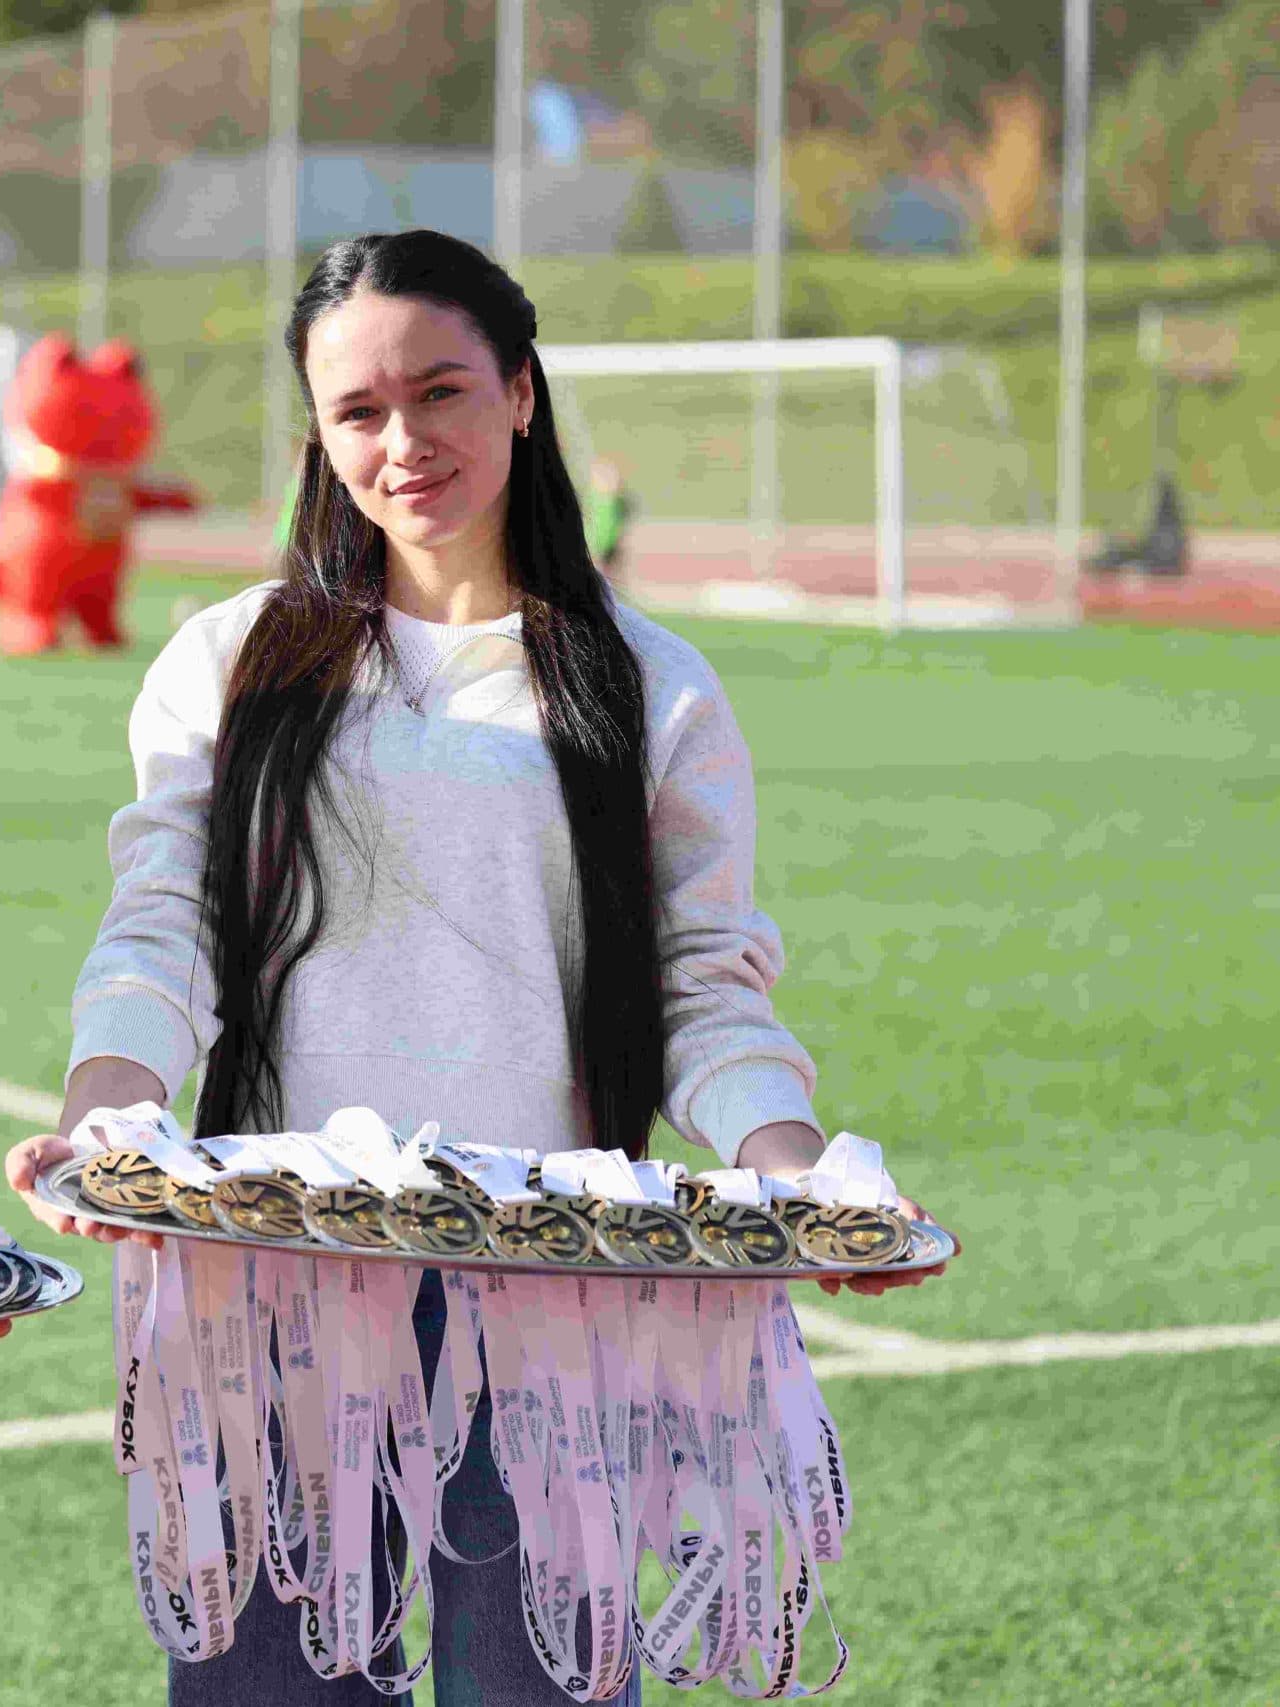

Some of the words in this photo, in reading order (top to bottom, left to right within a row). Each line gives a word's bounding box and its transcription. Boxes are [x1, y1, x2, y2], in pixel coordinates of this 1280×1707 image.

[121, 1356, 140, 1463] КУБОК
[819, 1417, 845, 1528] ИБИРИ
[267, 1479, 294, 1589] КУБОК
[305, 1598, 329, 1659] БОК
